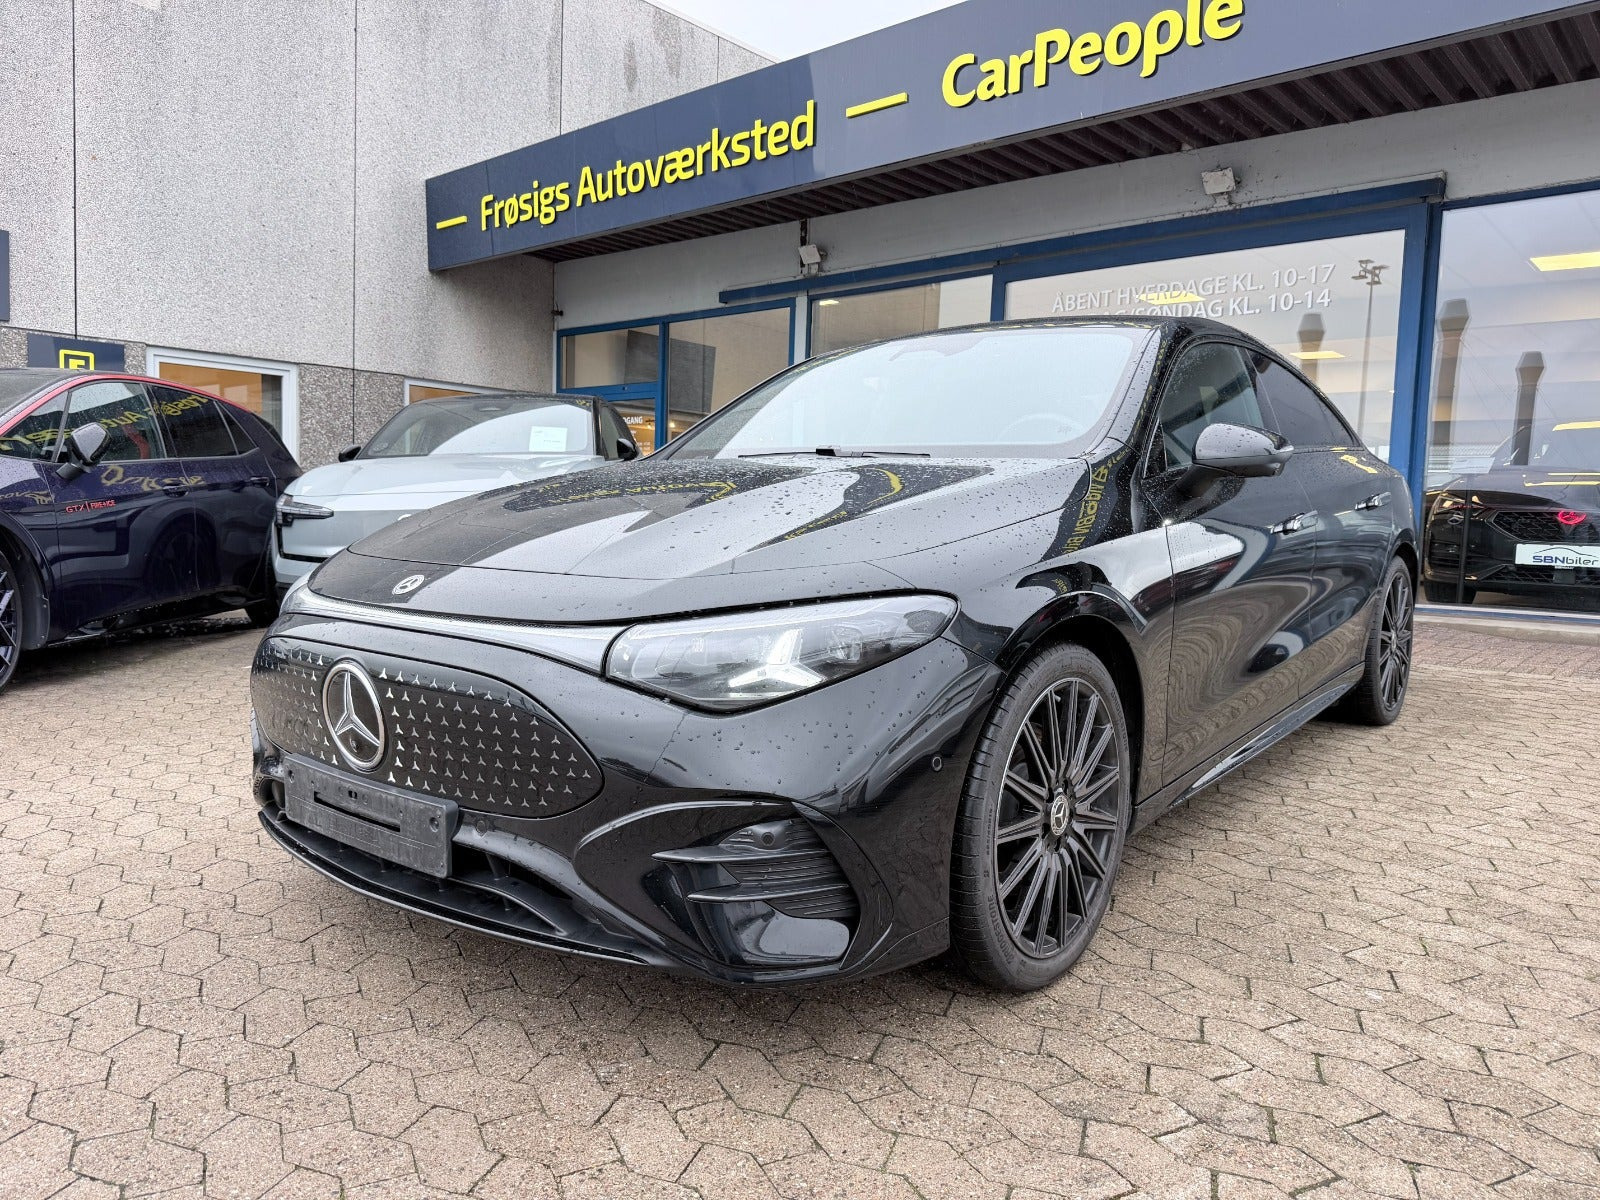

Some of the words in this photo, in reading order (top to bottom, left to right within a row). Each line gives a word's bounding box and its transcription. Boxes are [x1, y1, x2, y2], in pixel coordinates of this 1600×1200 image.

[481, 180, 570, 231] Frøsigs
[576, 100, 815, 206] Autoværksted
[942, 0, 1243, 107] CarPeople
[1052, 290, 1112, 313] ÅBENT
[1117, 276, 1227, 305] HVERDAGE
[1231, 272, 1264, 293] KL.
[1272, 263, 1336, 288] 10-17
[1228, 296, 1261, 316] KL.
[1268, 288, 1332, 313] 10-14
[65, 504, 85, 513] GTX
[1532, 555, 1599, 566] SBNbiler
